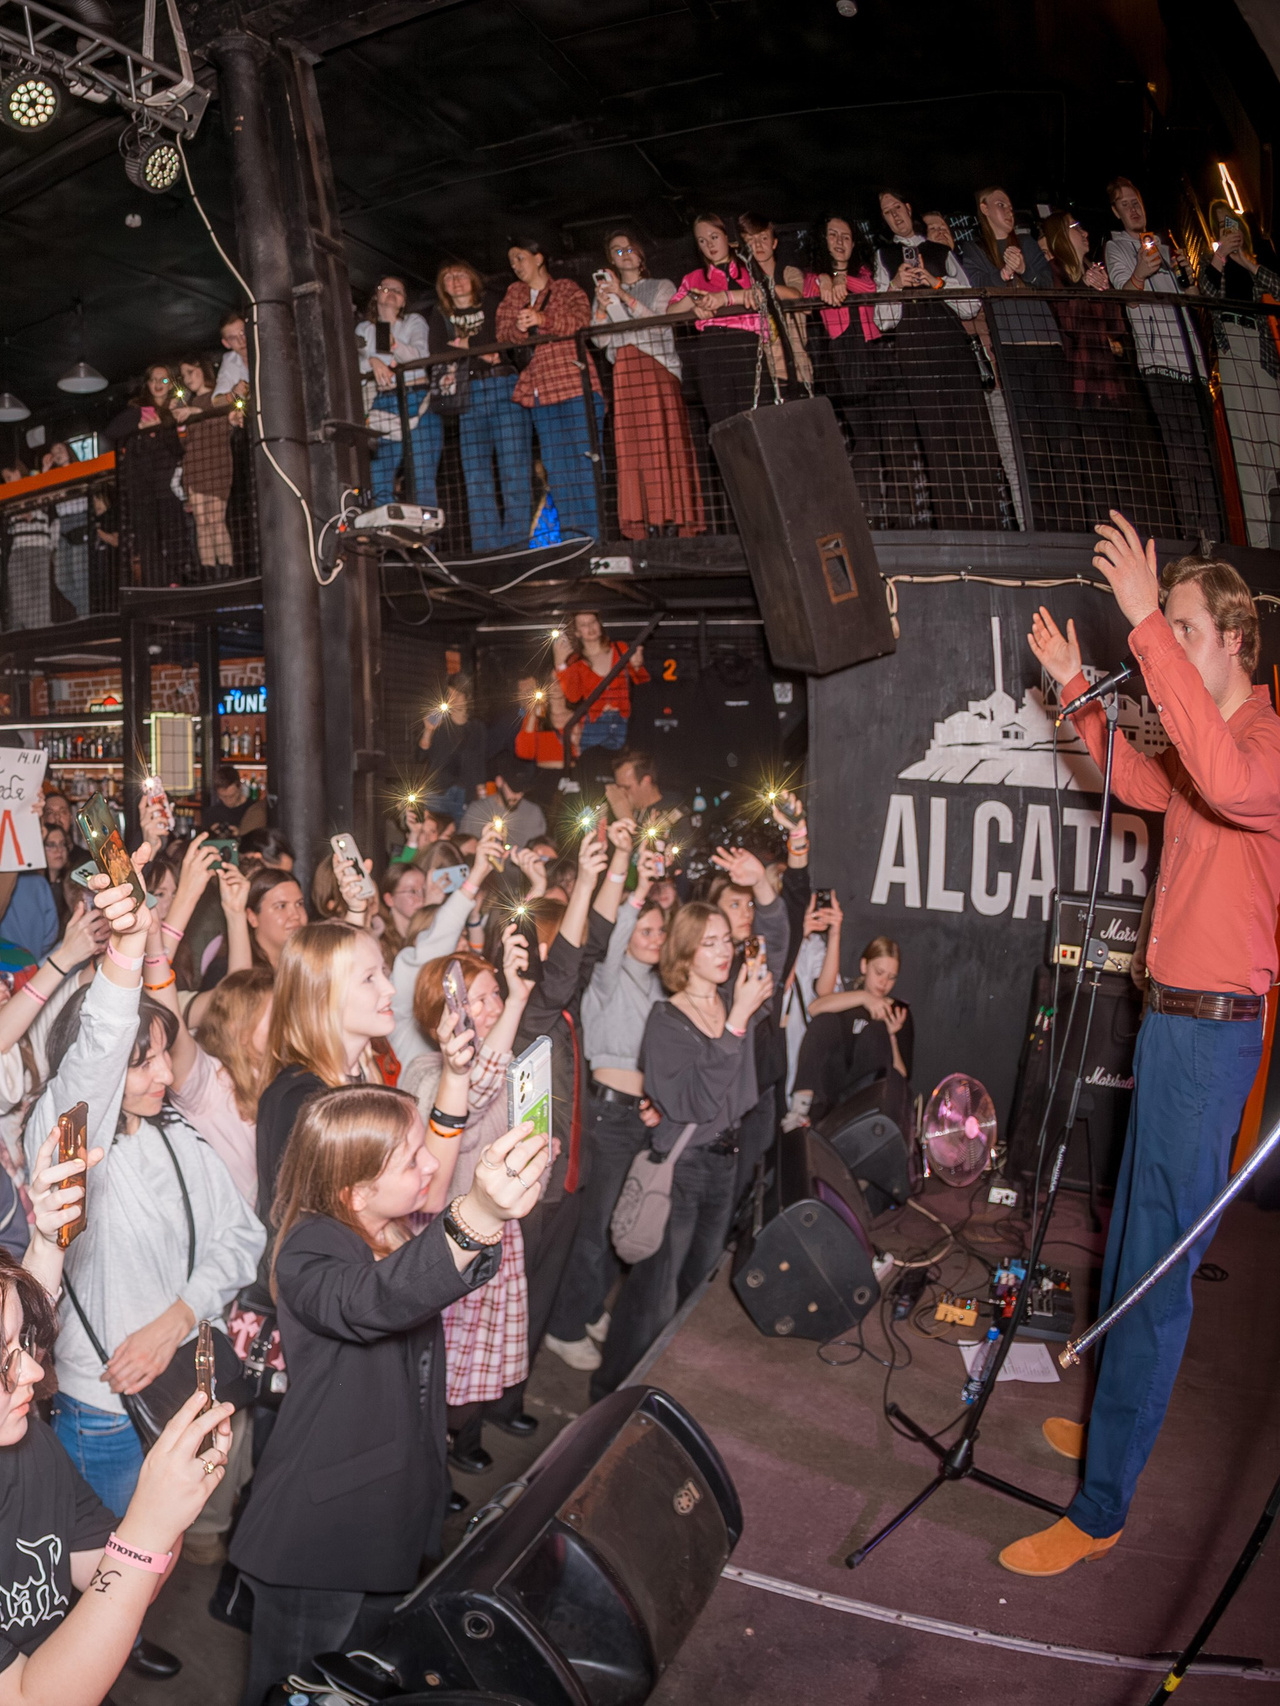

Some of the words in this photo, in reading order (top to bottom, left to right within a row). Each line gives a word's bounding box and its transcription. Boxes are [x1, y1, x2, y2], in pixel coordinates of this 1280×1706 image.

[663, 659, 677, 681] 2
[870, 794, 1150, 921] ALCATR
[1100, 918, 1139, 943] Mars
